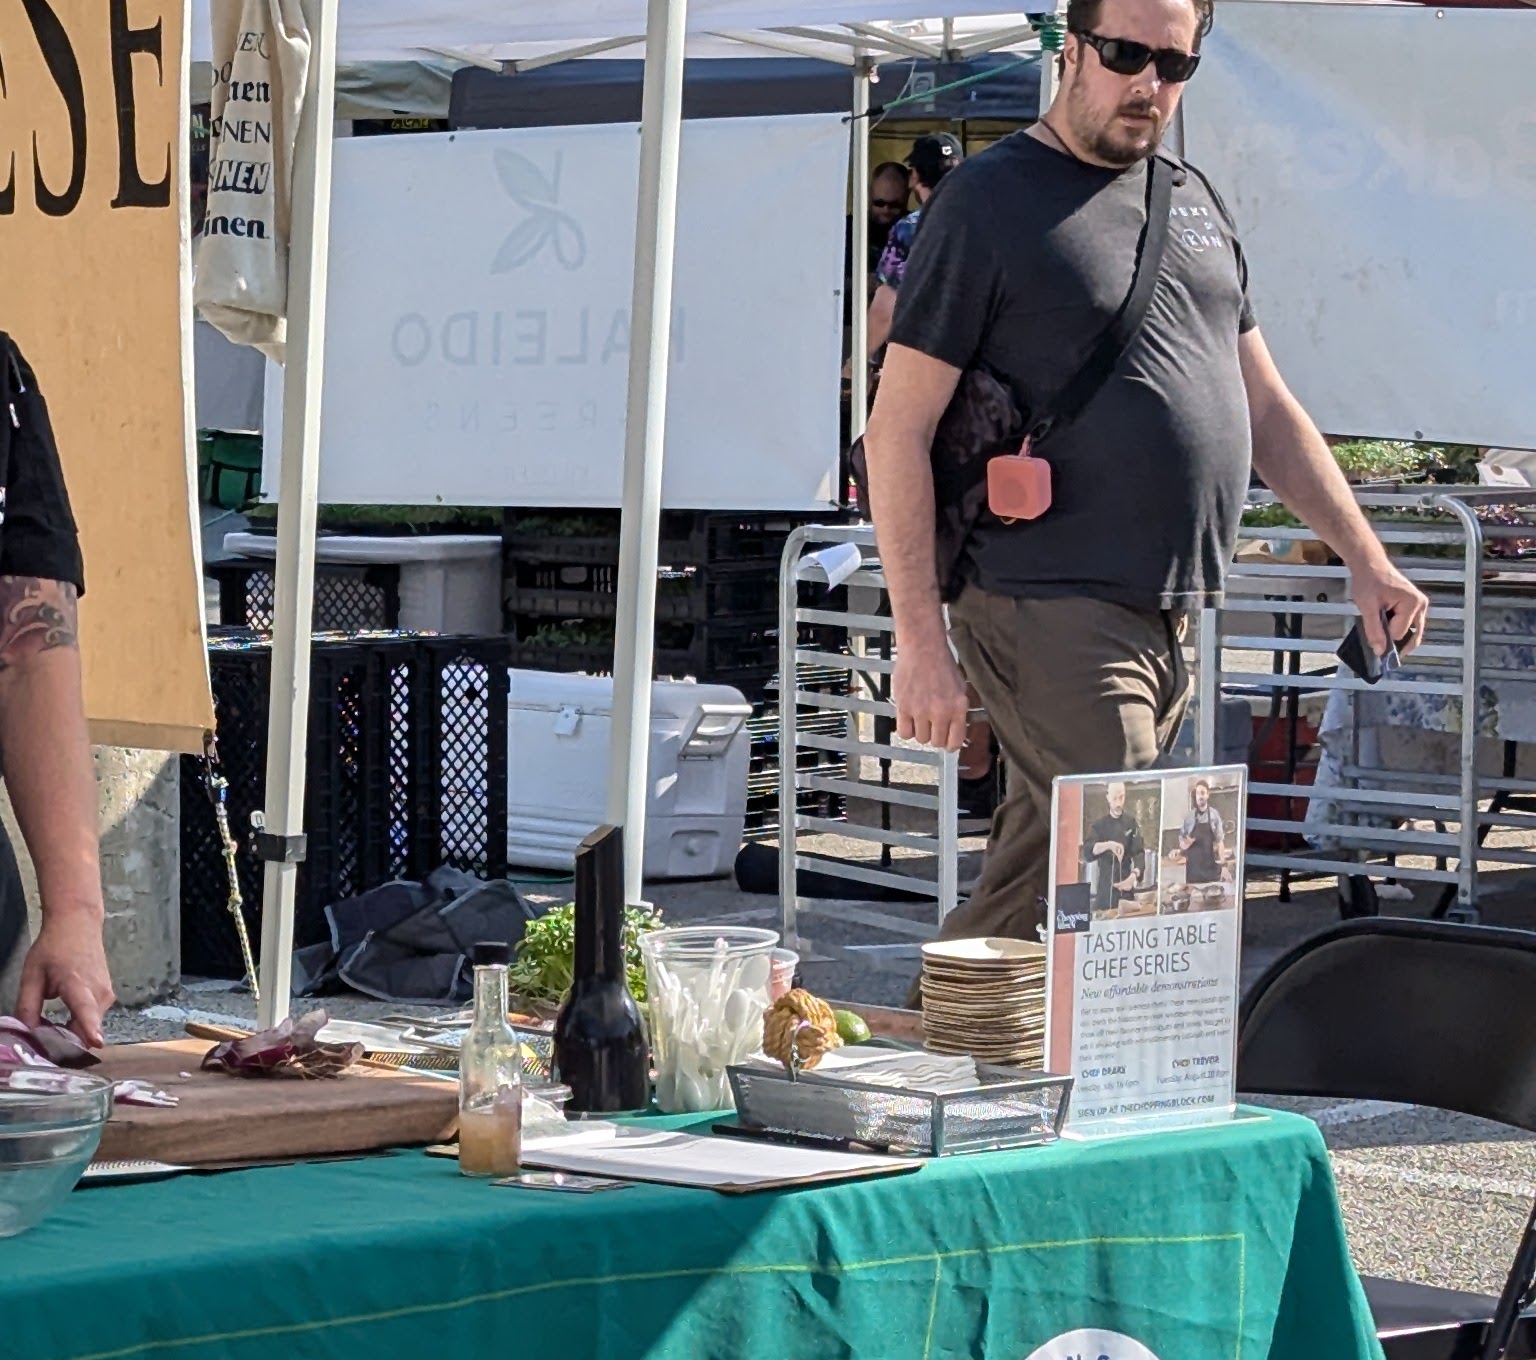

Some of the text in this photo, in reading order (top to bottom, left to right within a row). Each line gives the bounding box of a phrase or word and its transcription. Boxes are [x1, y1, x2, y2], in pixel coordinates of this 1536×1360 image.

[1082, 922, 1218, 955] TASTING TABLE
[1082, 951, 1190, 981] CHEF SERIES
